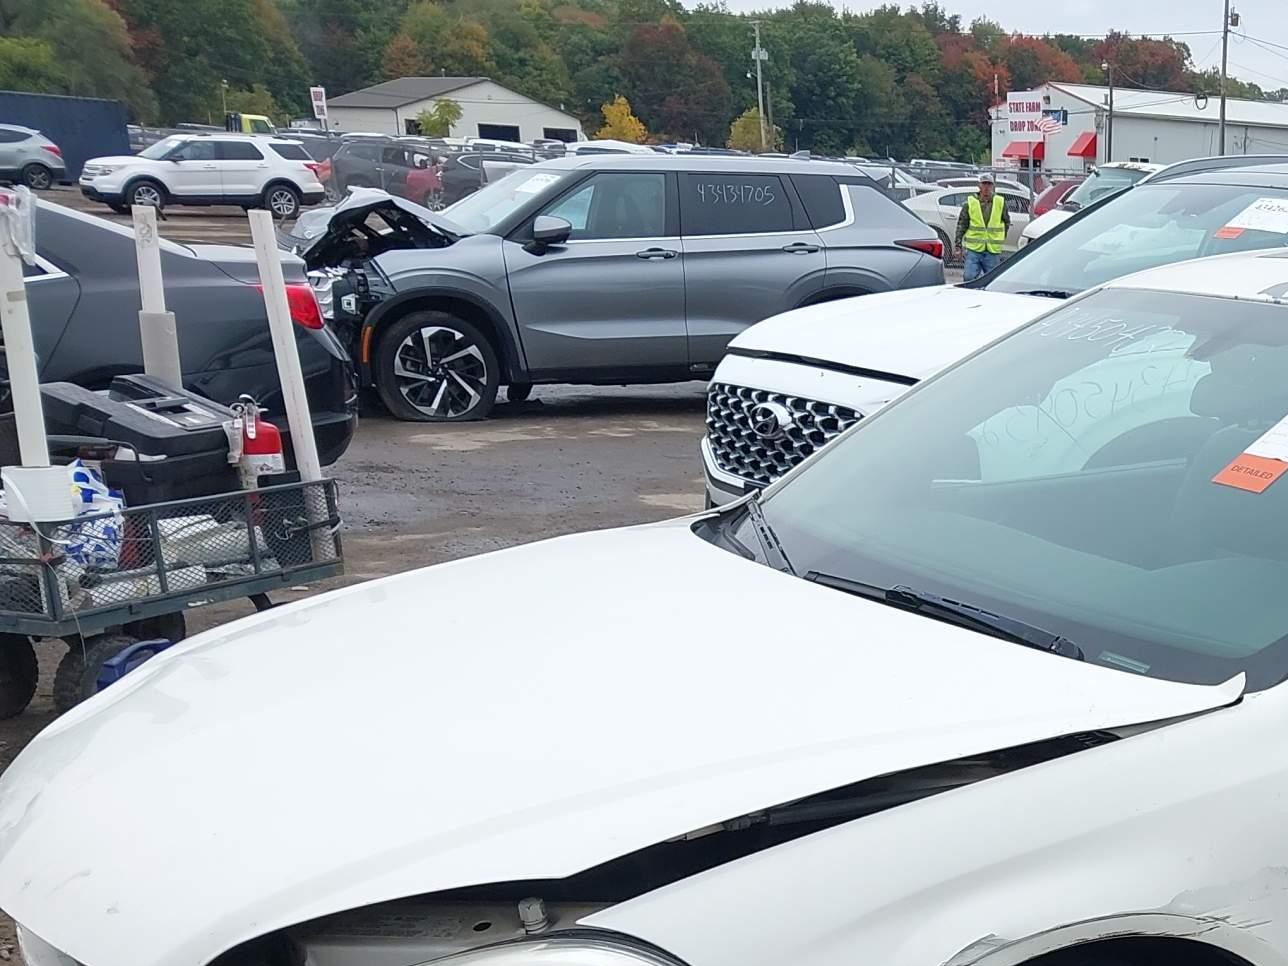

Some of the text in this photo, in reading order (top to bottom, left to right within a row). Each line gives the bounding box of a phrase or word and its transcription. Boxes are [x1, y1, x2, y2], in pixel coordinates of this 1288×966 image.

[1008, 101, 1041, 113] STATE FARM
[1009, 120, 1026, 132] DROP
[696, 183, 775, 206] 43434705
[1230, 464, 1273, 481] DETAILED
